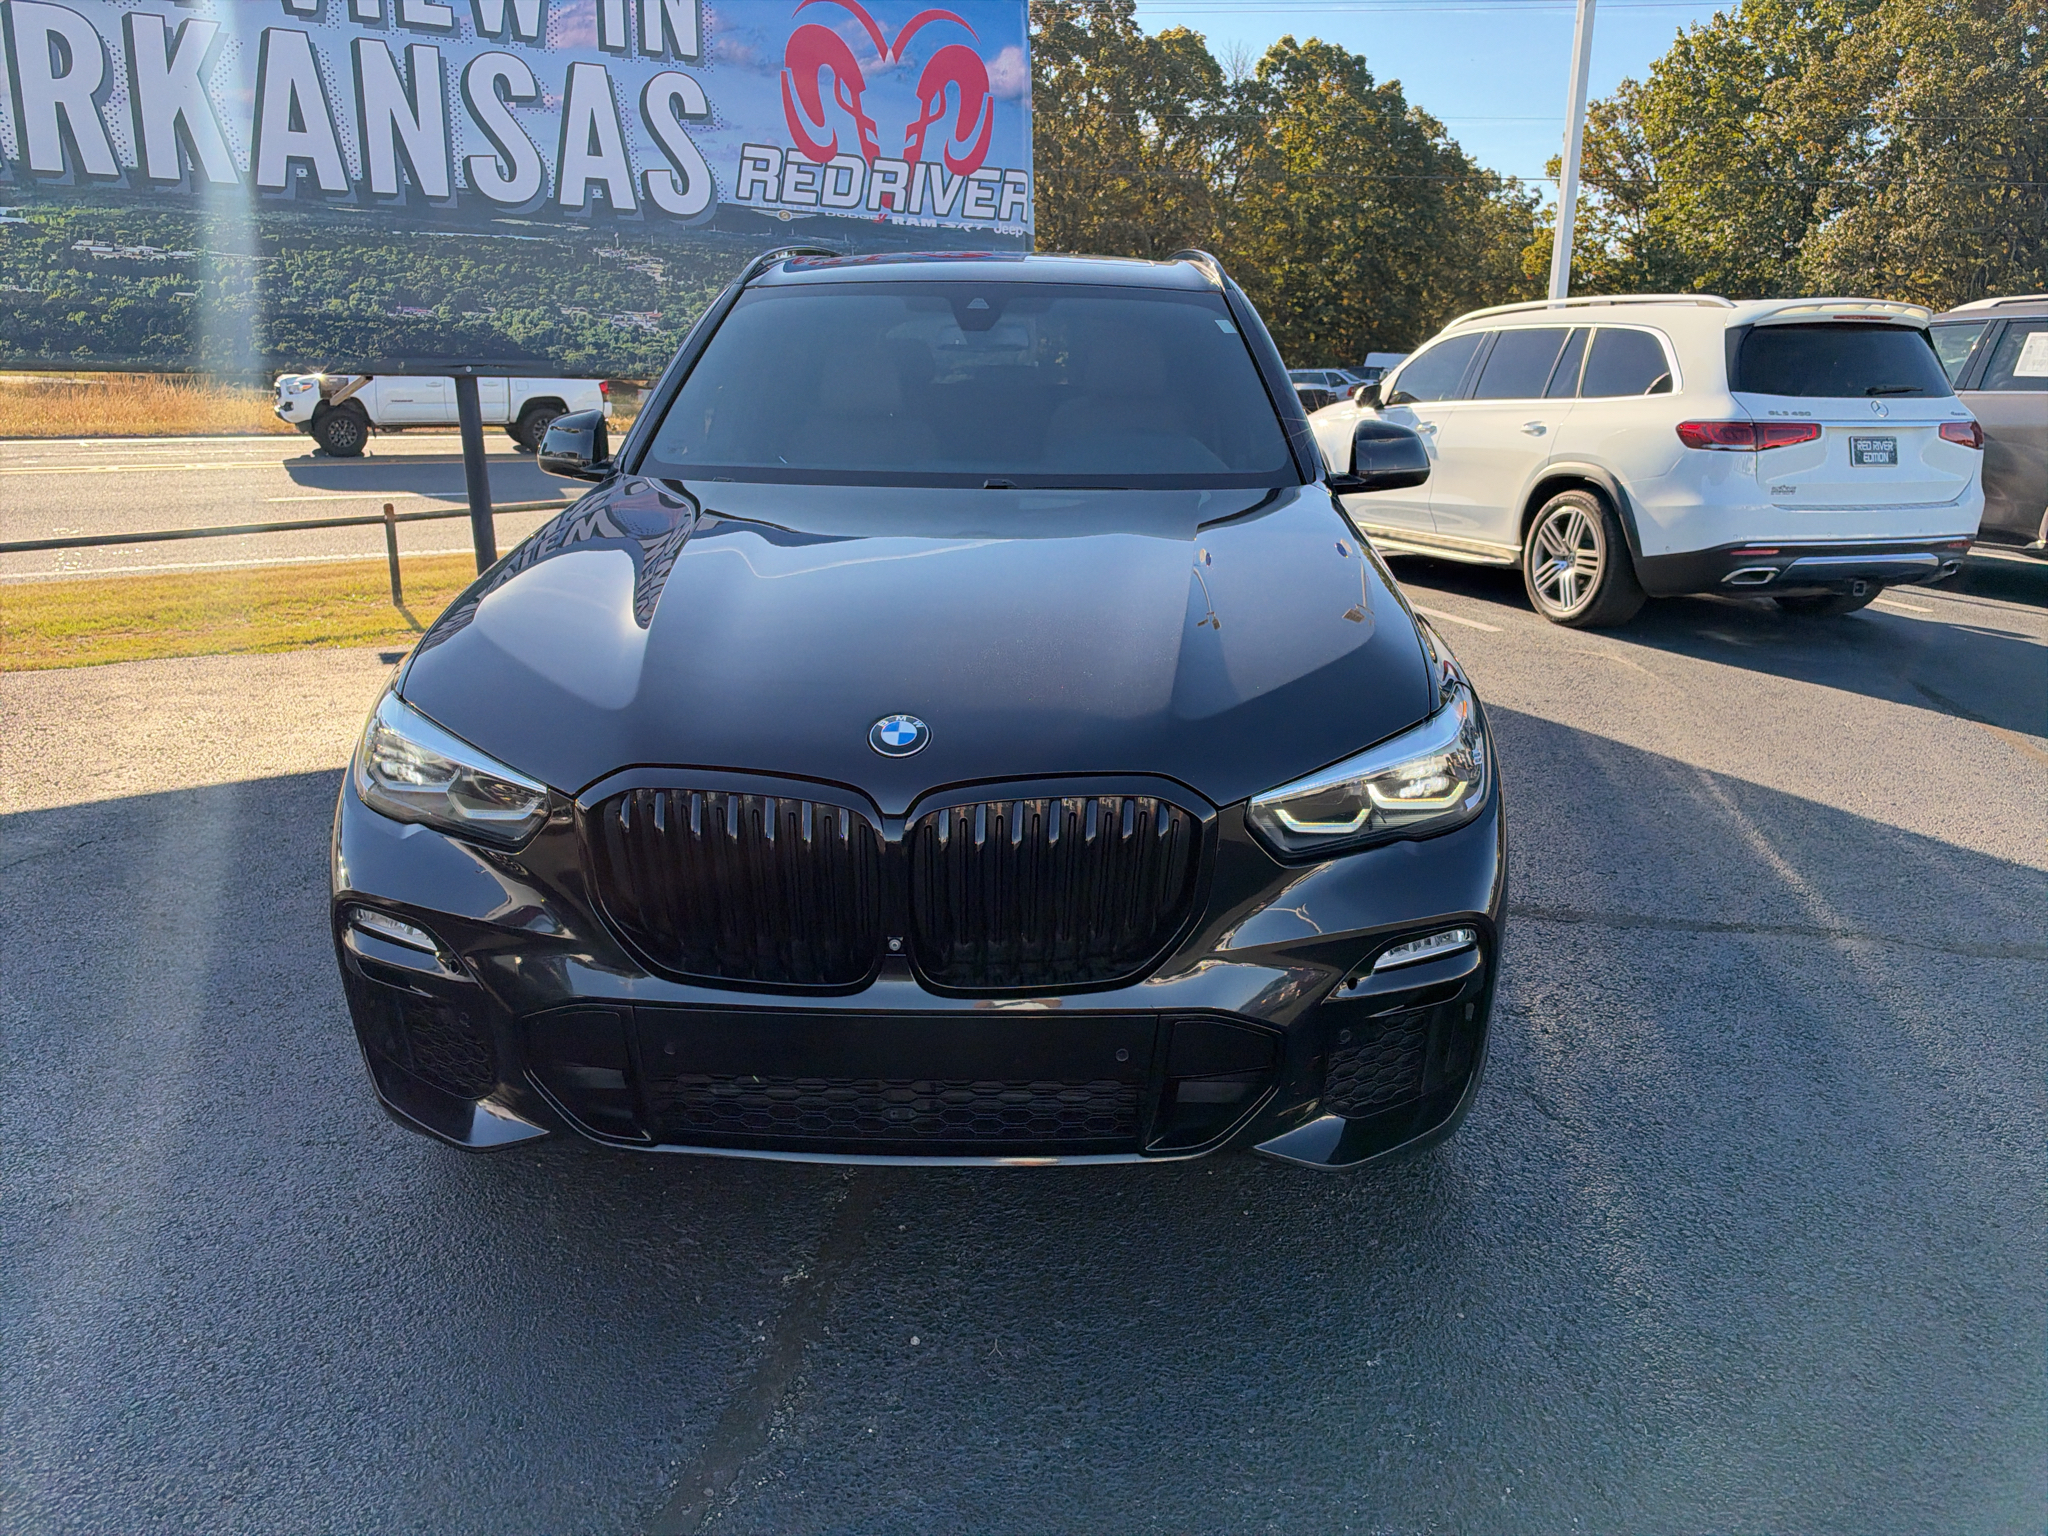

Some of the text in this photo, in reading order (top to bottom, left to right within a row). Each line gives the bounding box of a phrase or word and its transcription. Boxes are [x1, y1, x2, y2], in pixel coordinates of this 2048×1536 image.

[0, 0, 713, 218] RKANSAS
[892, 216, 938, 228] RAM
[994, 221, 1023, 238] Jeep
[1857, 440, 1894, 451] RED RIVER
[1863, 452, 1889, 463] EDITION
[877, 715, 925, 728] BMW
